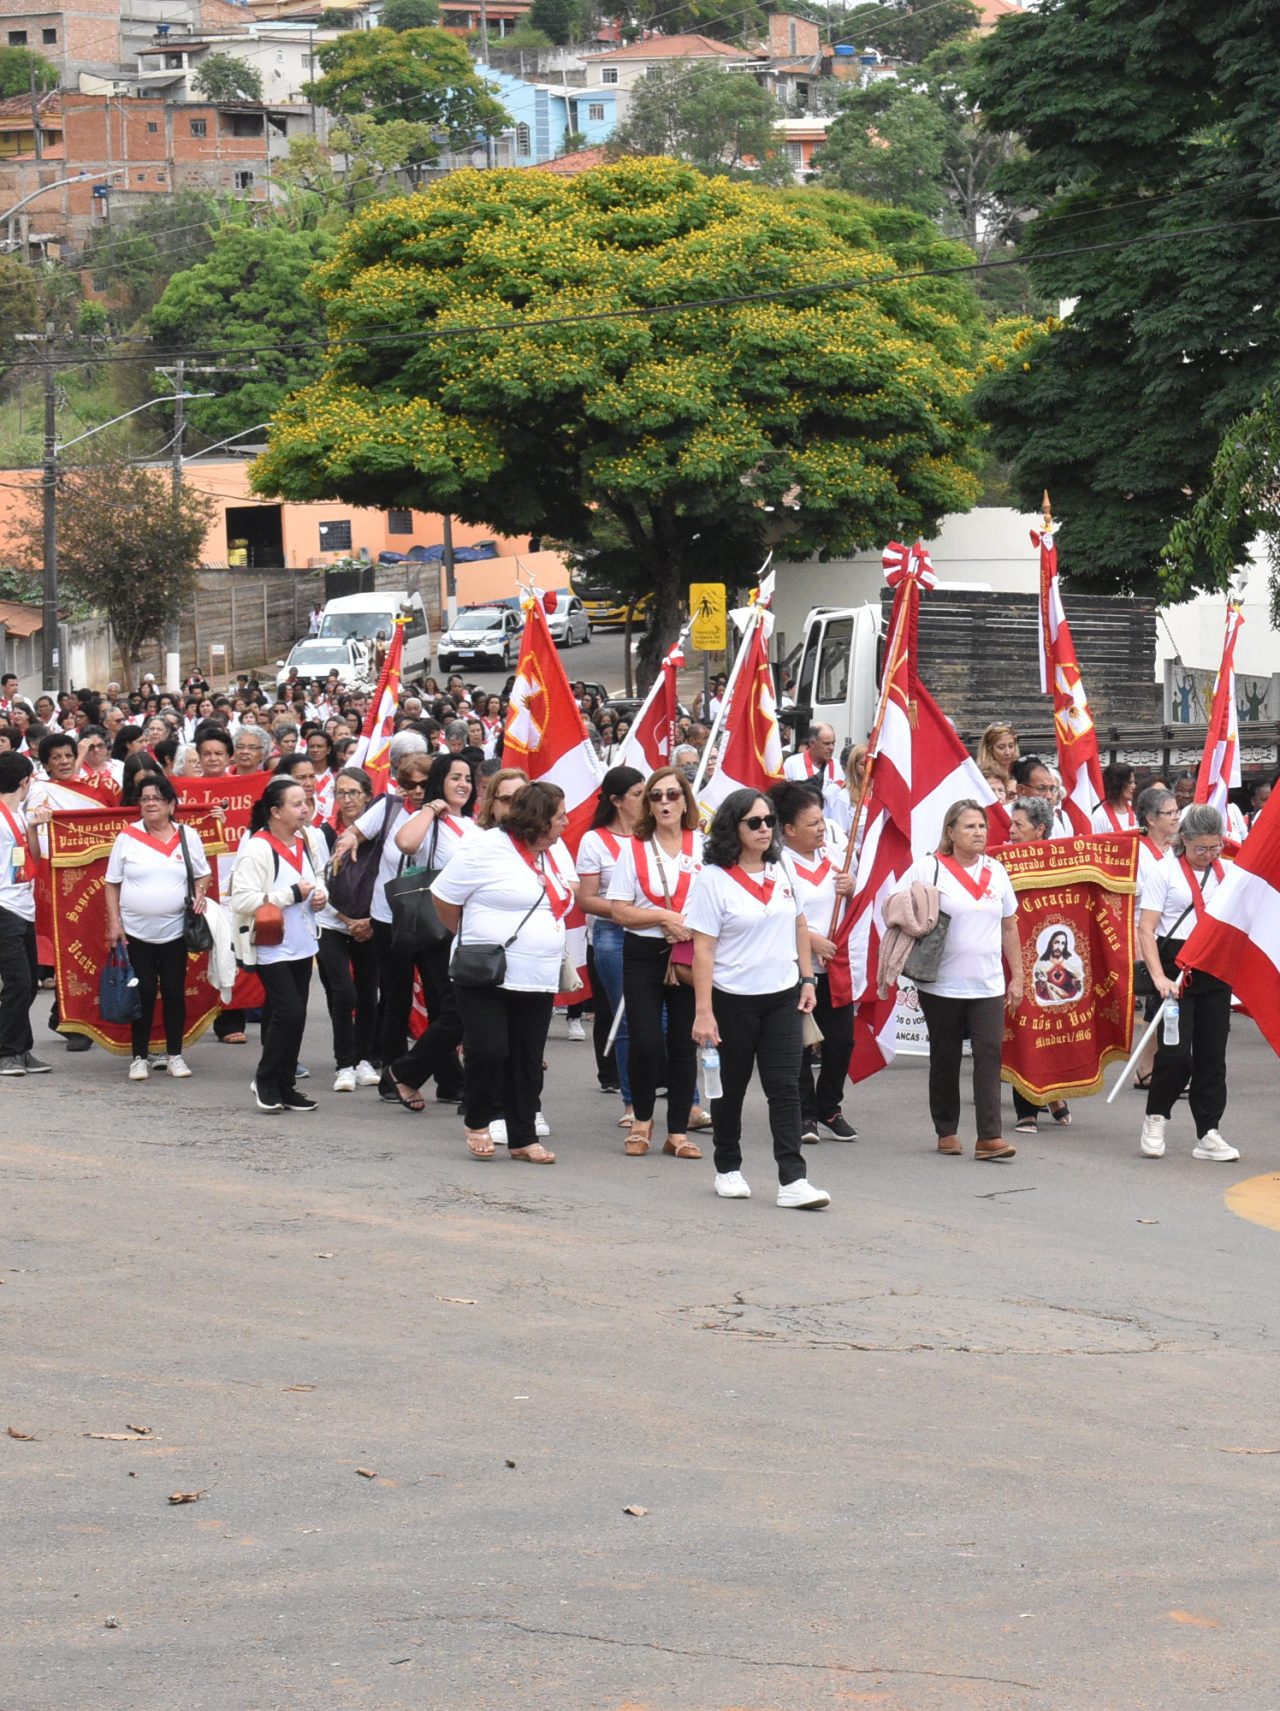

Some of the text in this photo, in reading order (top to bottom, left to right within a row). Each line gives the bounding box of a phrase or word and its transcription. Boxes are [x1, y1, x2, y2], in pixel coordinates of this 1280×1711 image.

[68, 820, 129, 835] Apostolad
[1051, 844, 1066, 855] da
[1074, 839, 1119, 853] Oração
[1005, 859, 1045, 873] Sagrado
[1049, 852, 1091, 867] Coração
[1094, 851, 1103, 863] de
[1022, 888, 1081, 912] Coração
[905, 1017, 911, 1025] O
[912, 1016, 926, 1025] VOS
